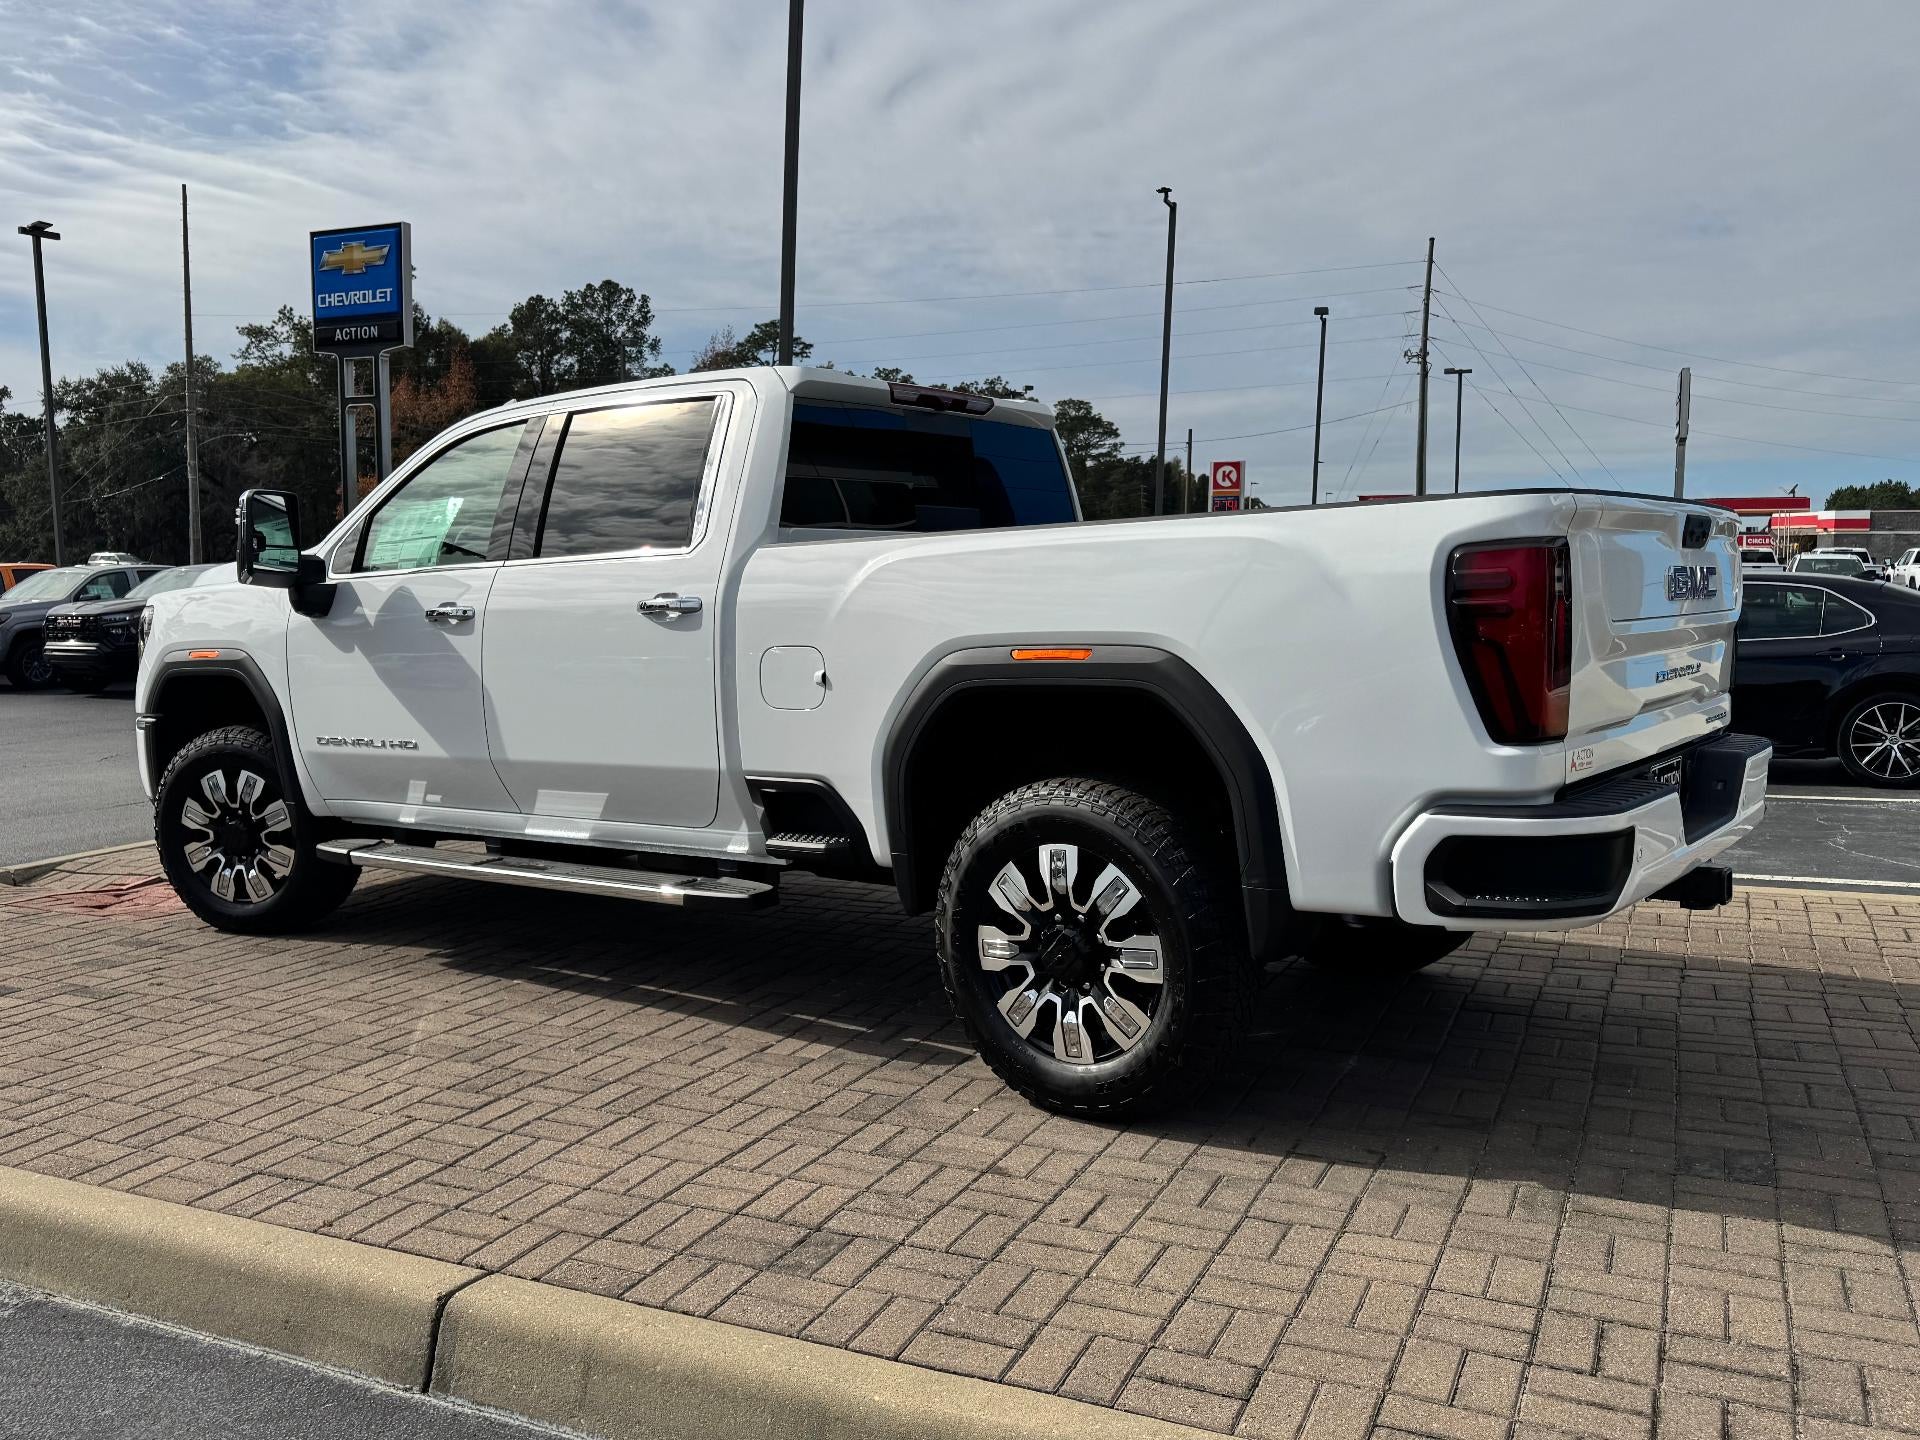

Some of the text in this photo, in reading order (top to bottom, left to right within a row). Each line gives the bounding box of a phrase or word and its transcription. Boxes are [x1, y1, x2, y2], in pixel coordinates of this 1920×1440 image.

[318, 288, 392, 307] CHEVROLET
[334, 326, 378, 341] ACTION
[1222, 469, 1235, 485] K
[1668, 566, 1718, 600] GMC
[316, 736, 419, 750] DENALI HD
